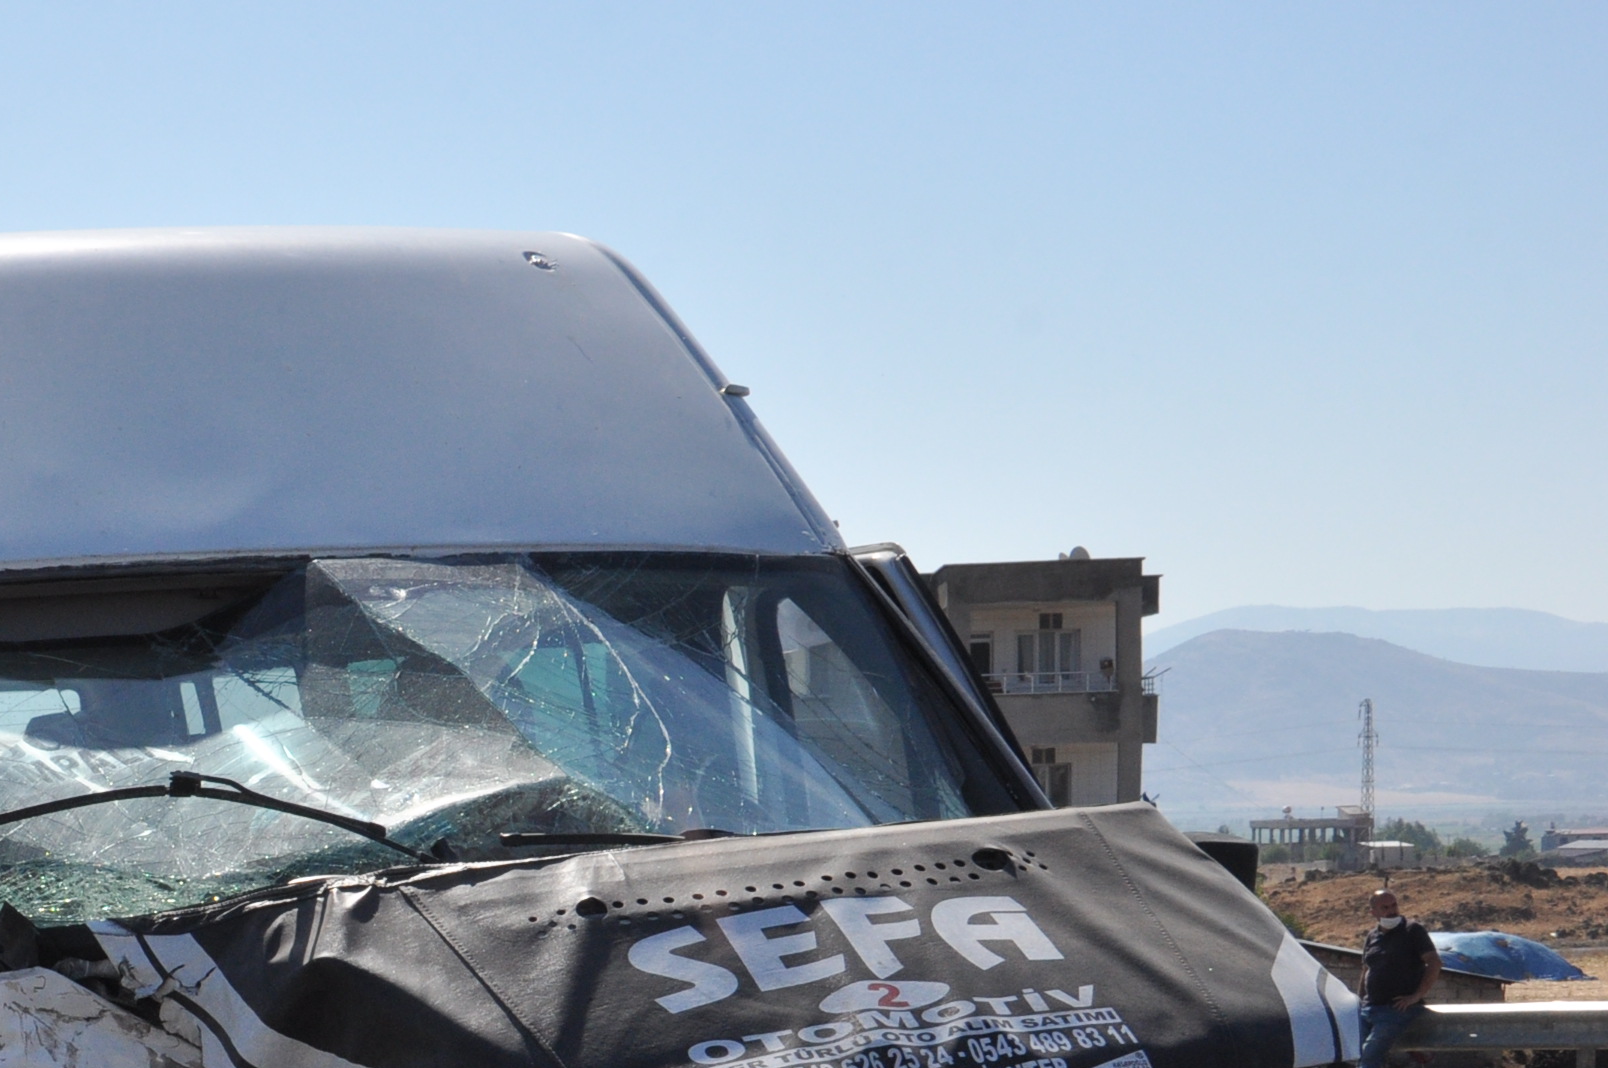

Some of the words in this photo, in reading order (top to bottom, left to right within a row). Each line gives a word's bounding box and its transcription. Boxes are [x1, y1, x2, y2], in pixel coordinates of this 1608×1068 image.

[627, 895, 1065, 1014] SEFA
[867, 982, 910, 1008] 2
[687, 984, 1094, 1065] OTOMOTİV
[774, 1035, 873, 1065] TÜRLÜ
[880, 1031, 937, 1043] OTO
[947, 1017, 1014, 1037] ALIM
[1021, 1009, 1117, 1030] SATIMI
[967, 1032, 1028, 1064] 0543
[1028, 1030, 1072, 1054] 489
[1072, 1026, 1107, 1048] 83
[1107, 1023, 1139, 1045] 11
